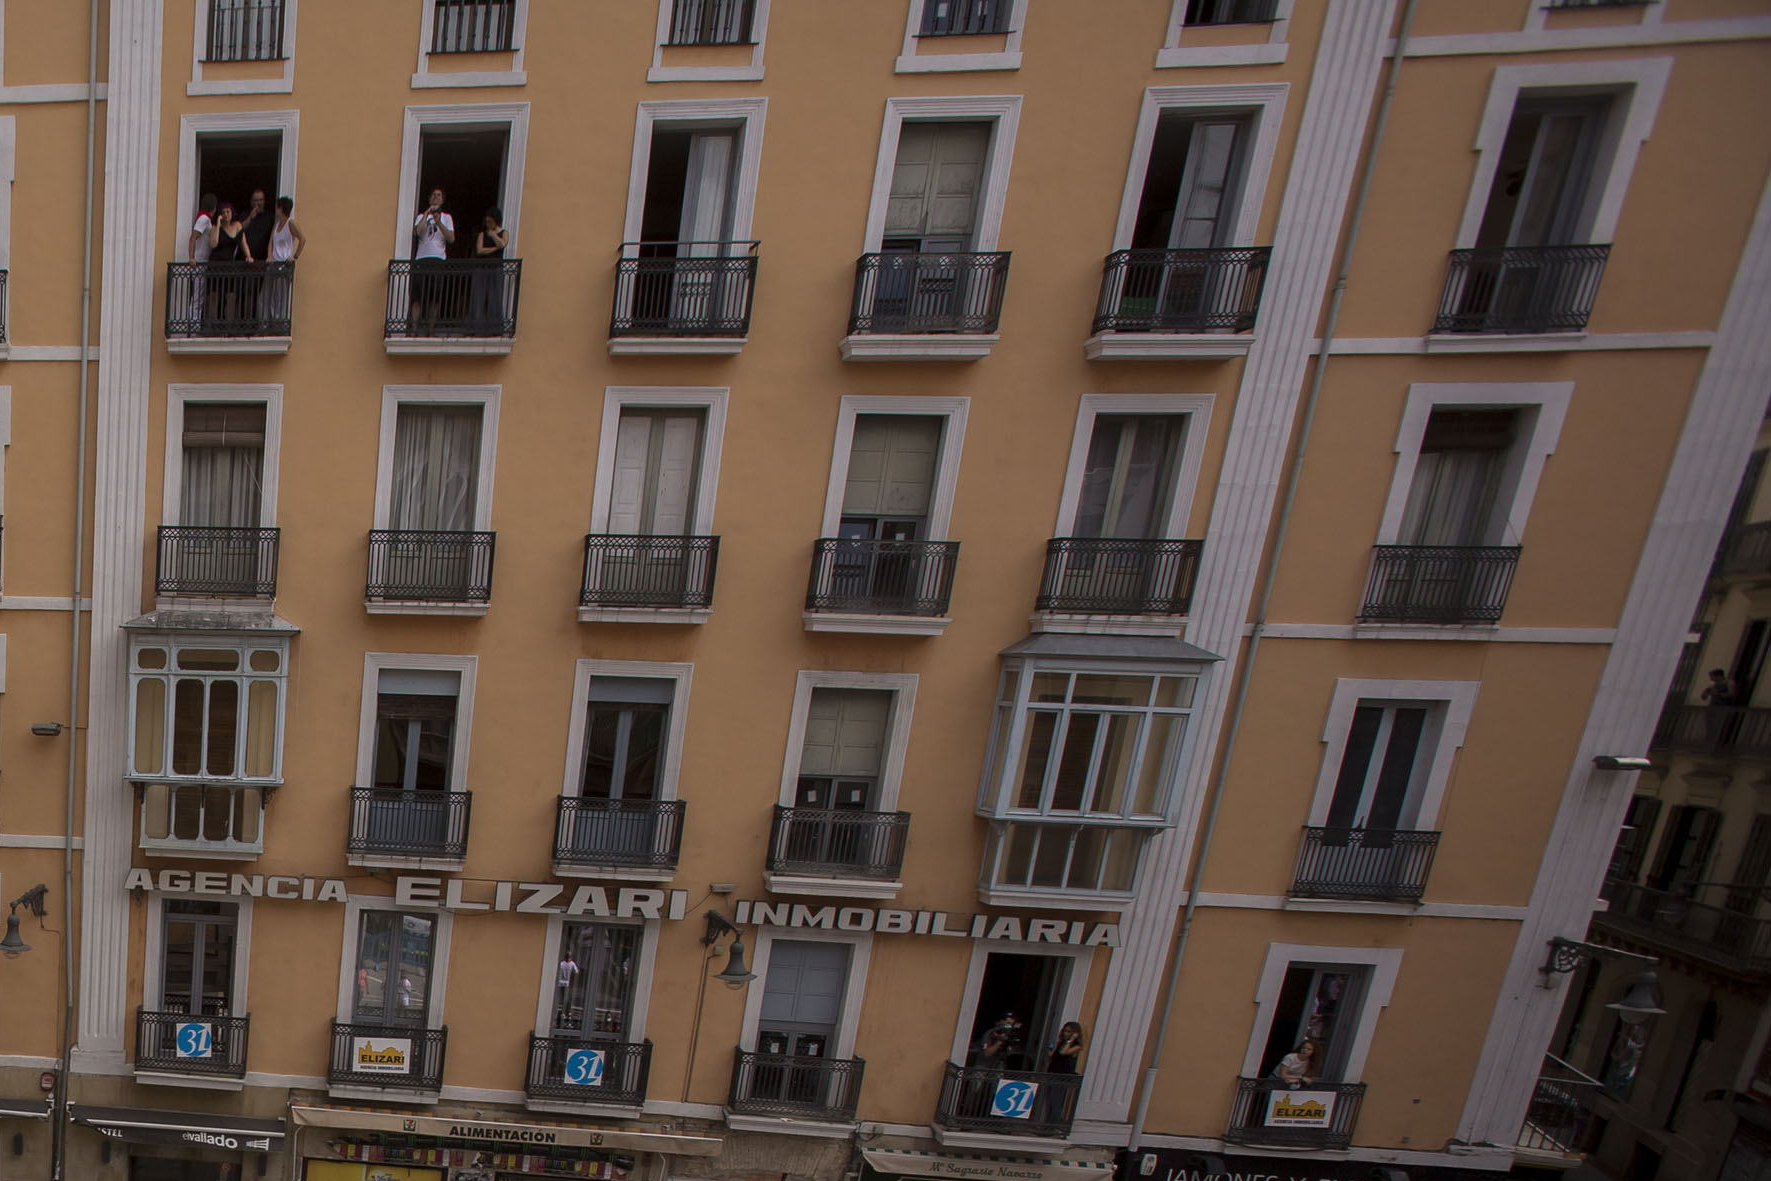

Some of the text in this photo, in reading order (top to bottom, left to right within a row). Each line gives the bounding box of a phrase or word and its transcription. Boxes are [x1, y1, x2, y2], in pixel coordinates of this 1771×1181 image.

[125, 868, 1123, 948] AGENCIA ELIZARI INMOBILIARIA
[184, 1029, 209, 1055] 31
[361, 1055, 405, 1064] ELIZARI
[574, 1056, 600, 1081] 31
[1003, 1087, 1032, 1113] 31
[1276, 1108, 1326, 1117] ELIZARI
[97, 1127, 124, 1138] STEL
[449, 1126, 556, 1143] ALIMENTACIÓN
[947, 1163, 994, 1176] Sagrario
[997, 1167, 1043, 1180] Navarro
